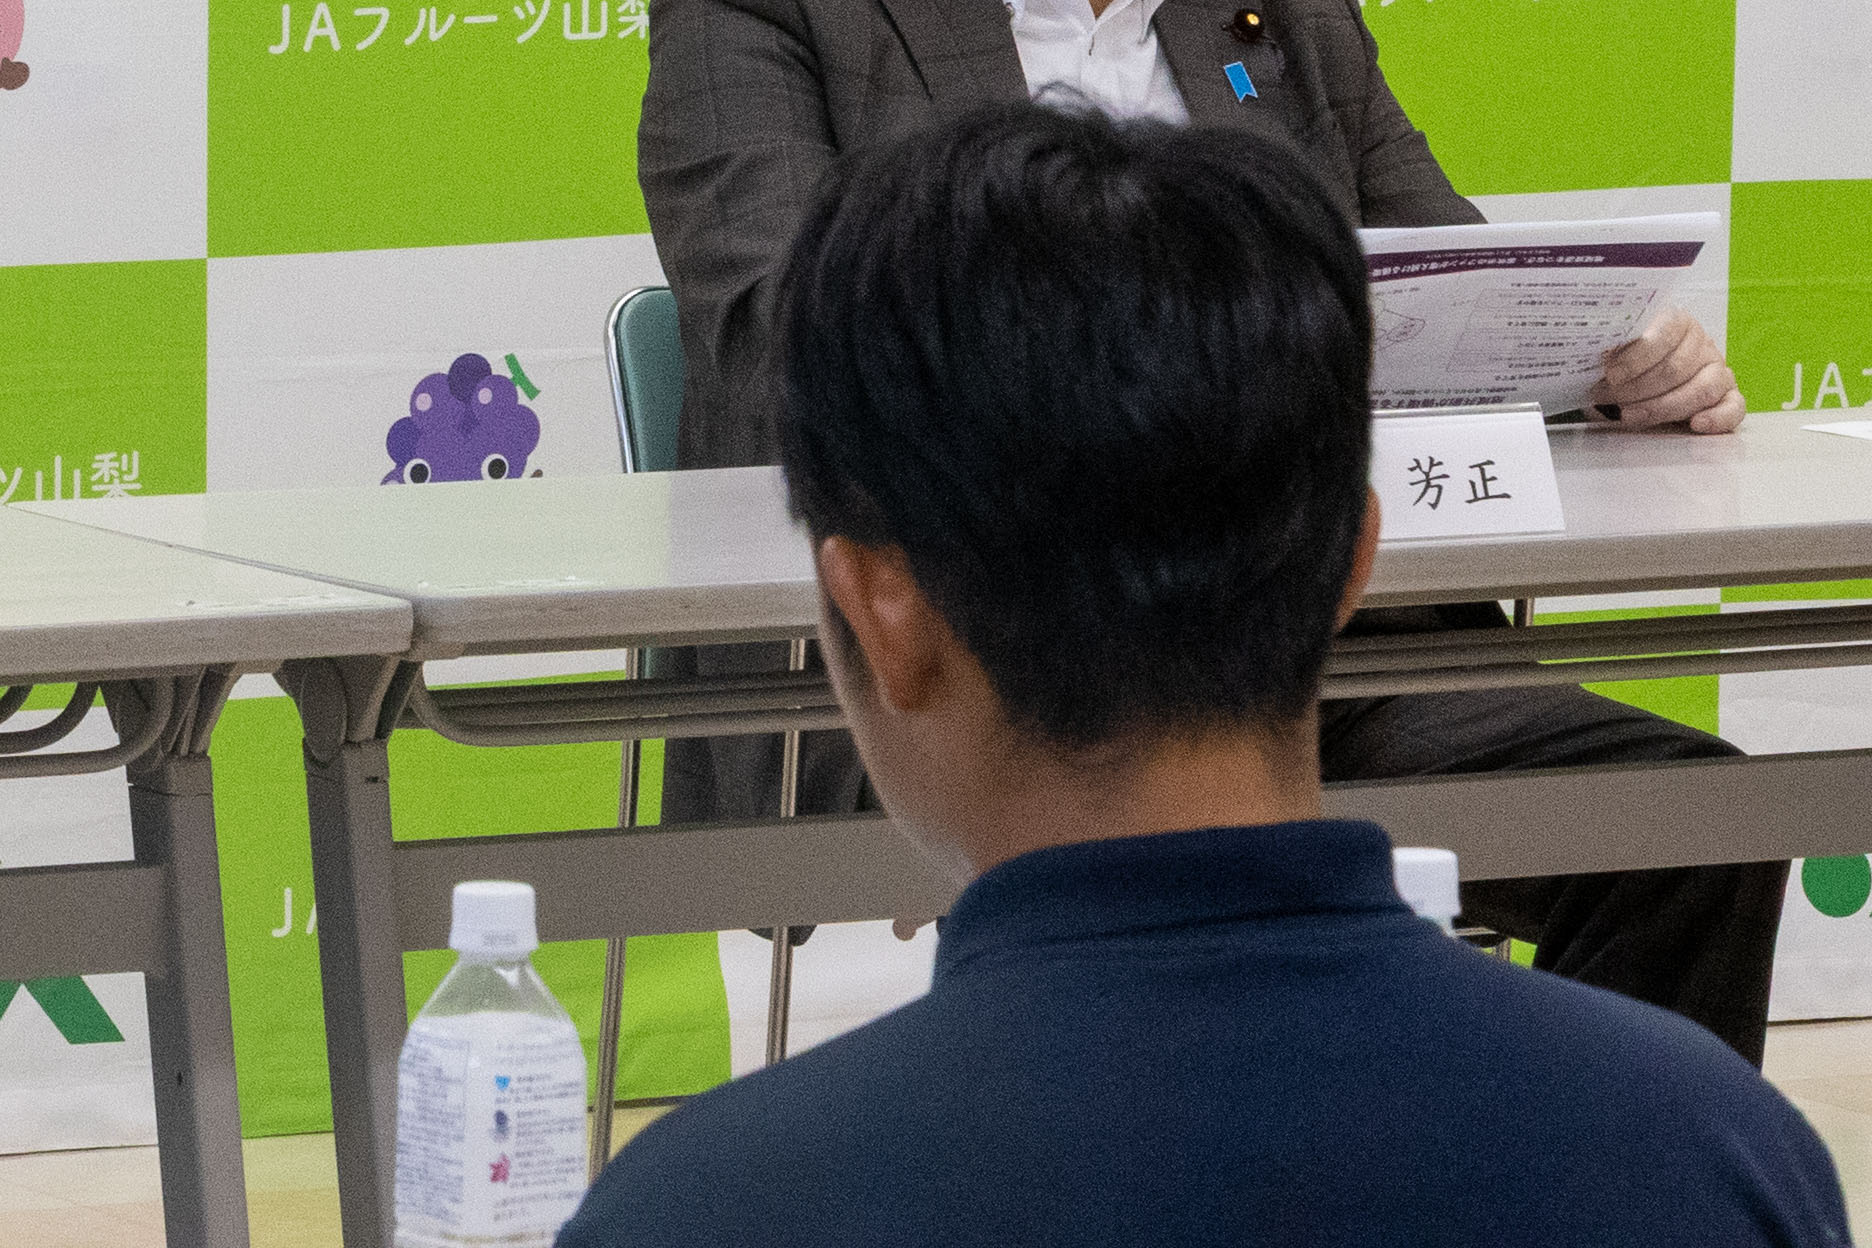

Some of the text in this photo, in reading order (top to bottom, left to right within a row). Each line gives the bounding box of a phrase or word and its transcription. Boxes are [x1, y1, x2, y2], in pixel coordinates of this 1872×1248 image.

[1781, 362, 1872, 410] JA
[1407, 455, 1512, 511] 芳正
[271, 887, 318, 938] J
